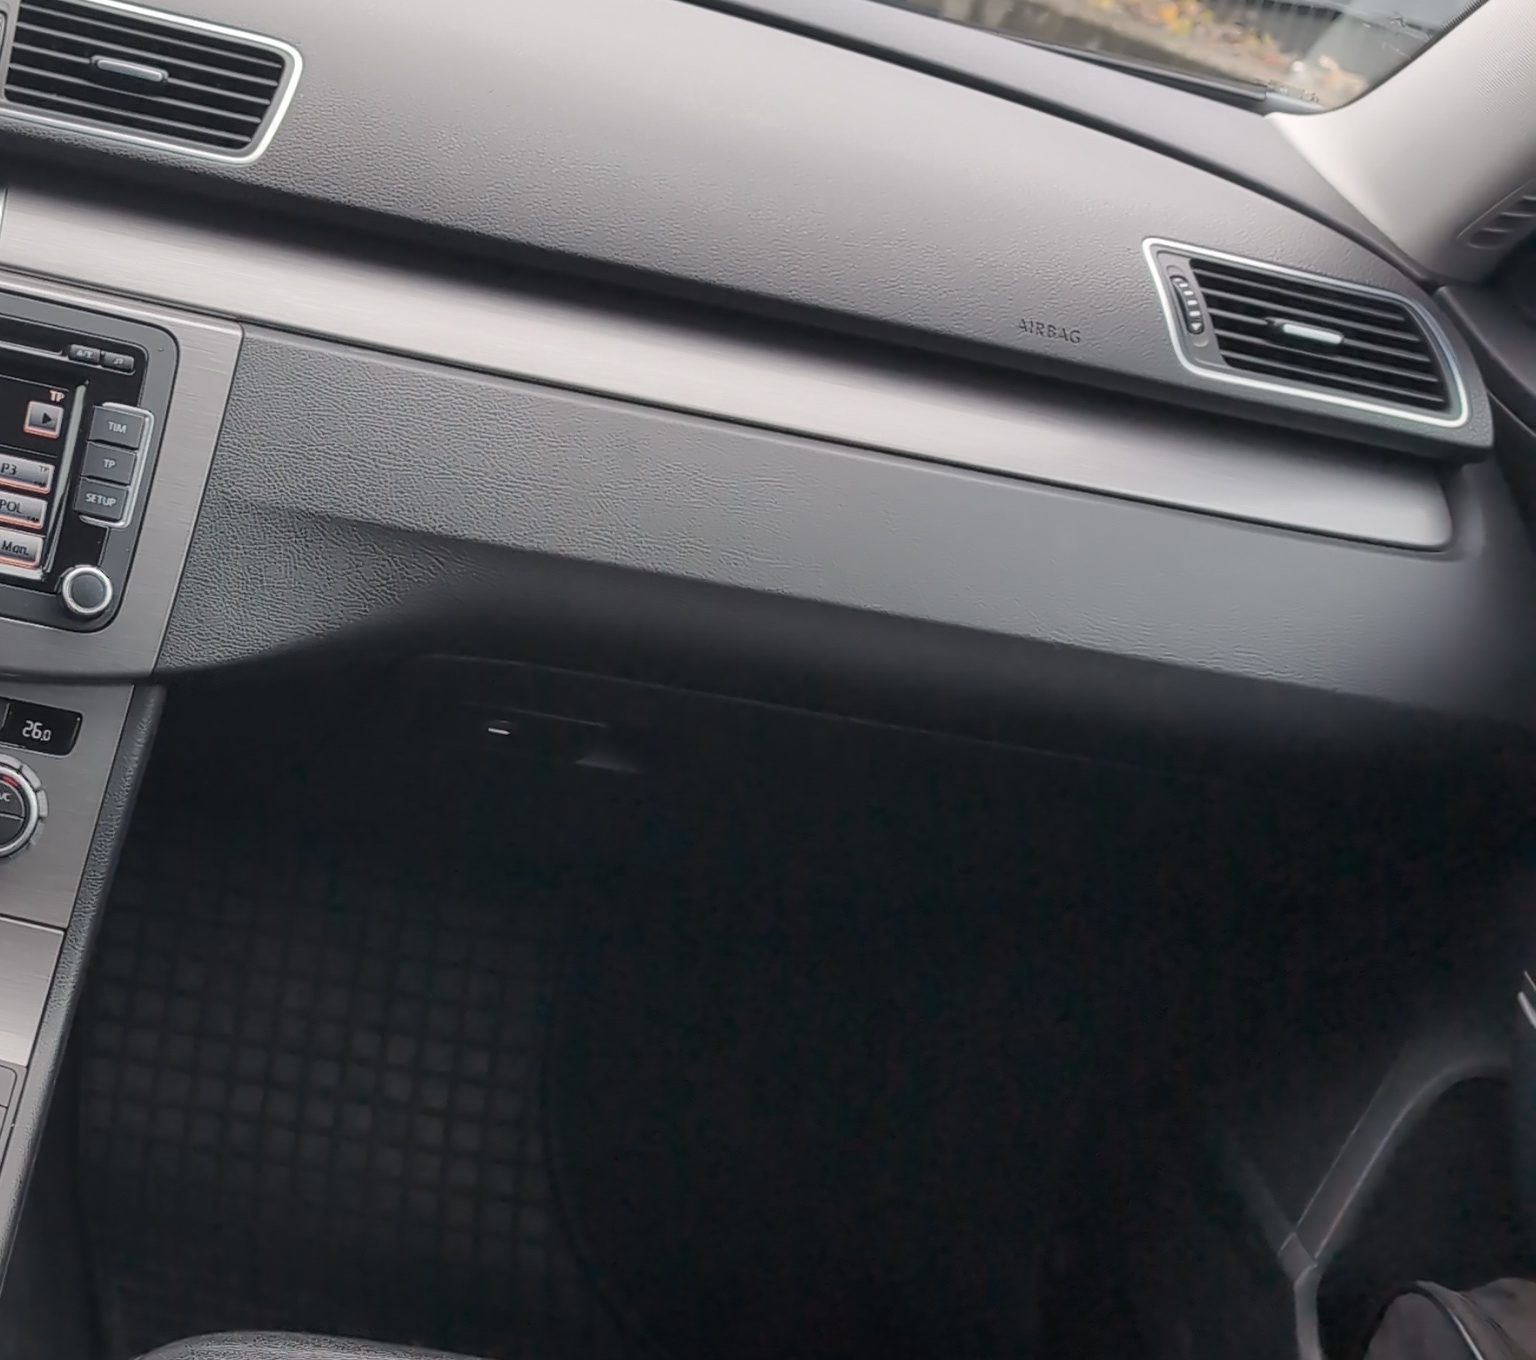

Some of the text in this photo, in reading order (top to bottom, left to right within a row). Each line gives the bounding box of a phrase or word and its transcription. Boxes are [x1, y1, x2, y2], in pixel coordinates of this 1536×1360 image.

[1018, 316, 1081, 345] AIRBAG
[50, 390, 65, 402] TP
[107, 421, 127, 434] TIM
[0, 462, 18, 476] P3
[102, 458, 116, 469] TP
[85, 492, 117, 508] SETUP
